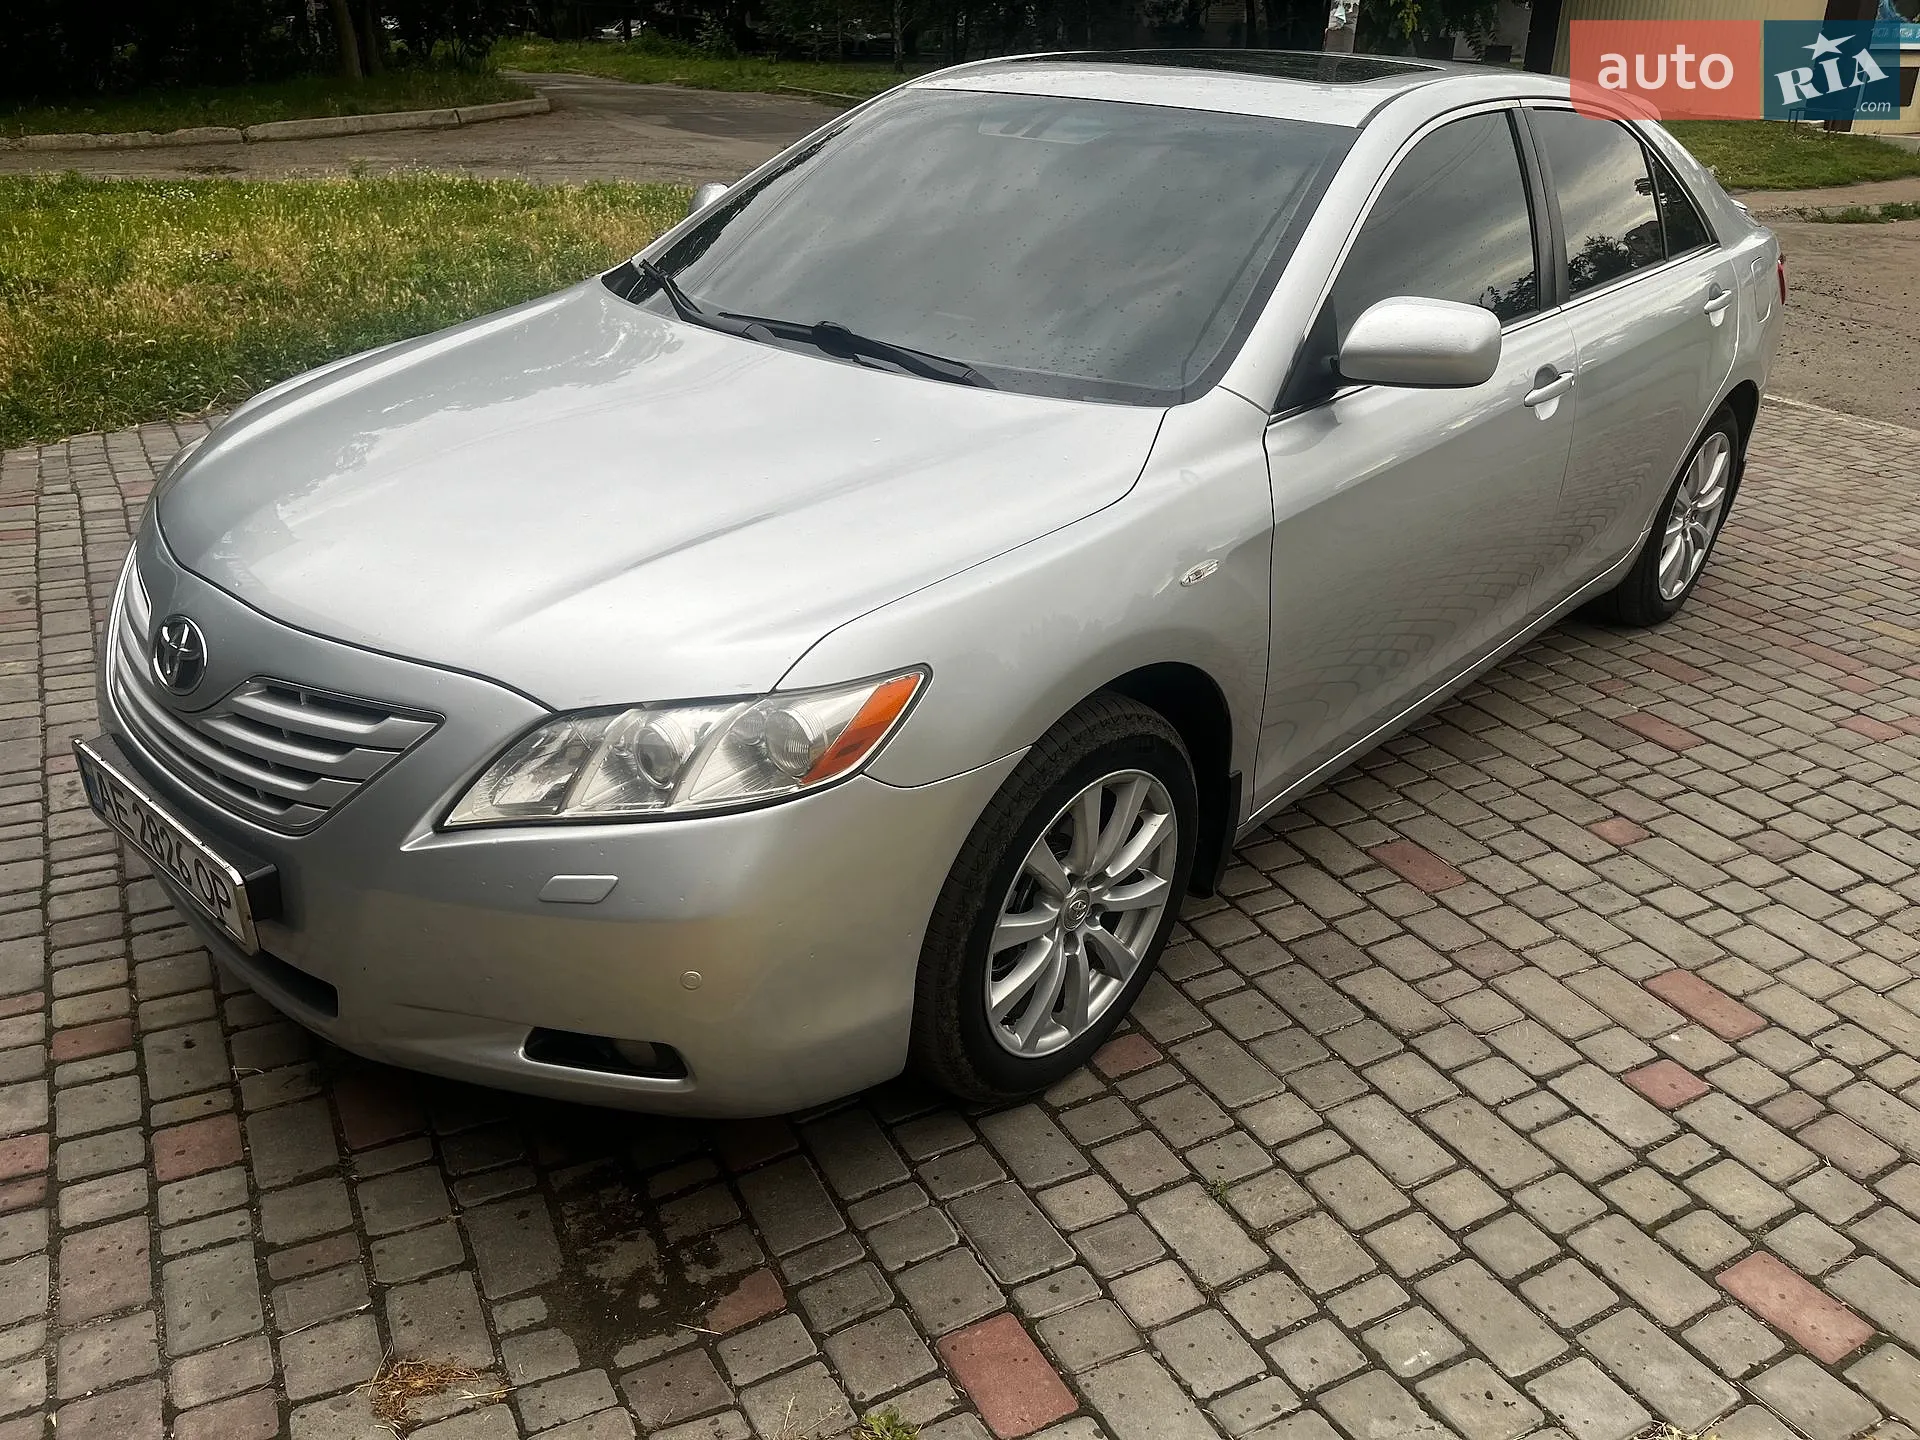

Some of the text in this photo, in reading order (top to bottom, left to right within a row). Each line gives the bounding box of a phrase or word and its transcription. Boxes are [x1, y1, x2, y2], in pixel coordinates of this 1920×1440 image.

[98, 772, 232, 918] AE 2826 OP
